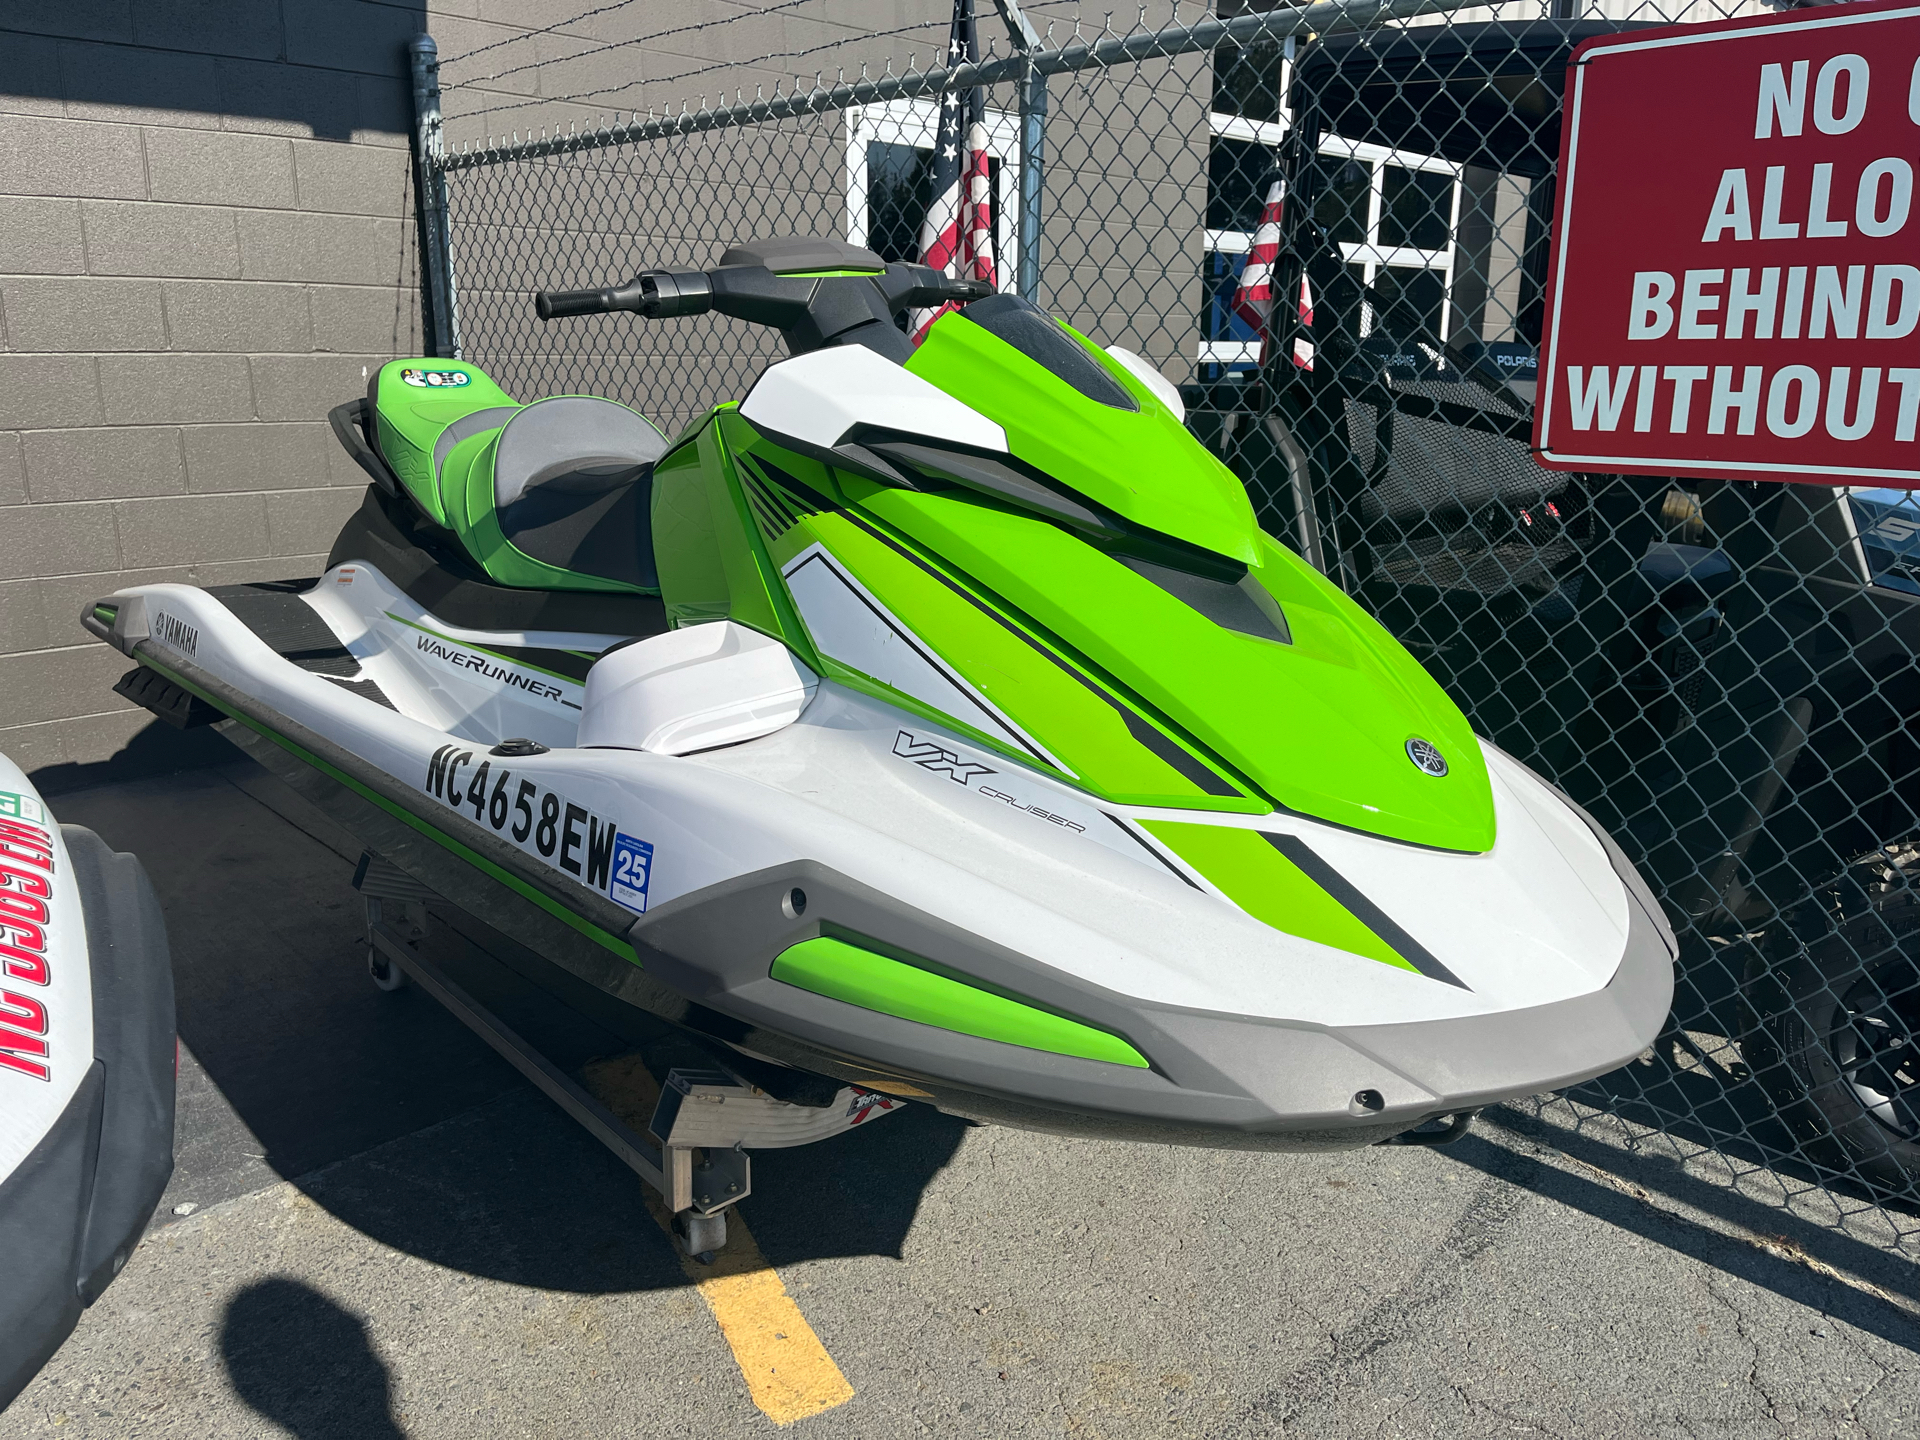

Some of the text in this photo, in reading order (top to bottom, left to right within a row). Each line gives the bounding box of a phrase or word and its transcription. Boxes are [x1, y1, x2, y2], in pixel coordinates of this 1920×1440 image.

[1755, 54, 1869, 139] NO
[1628, 264, 1920, 340] BEHIND
[1497, 354, 1537, 368] POLARIS
[1567, 365, 1920, 442] WITHOUT
[164, 613, 199, 658] YAMAHA
[417, 635, 563, 702] WAVERUNNER
[425, 743, 617, 891] NC4658EW
[892, 730, 1087, 834] VX CRUISER
[615, 849, 647, 888] 25
